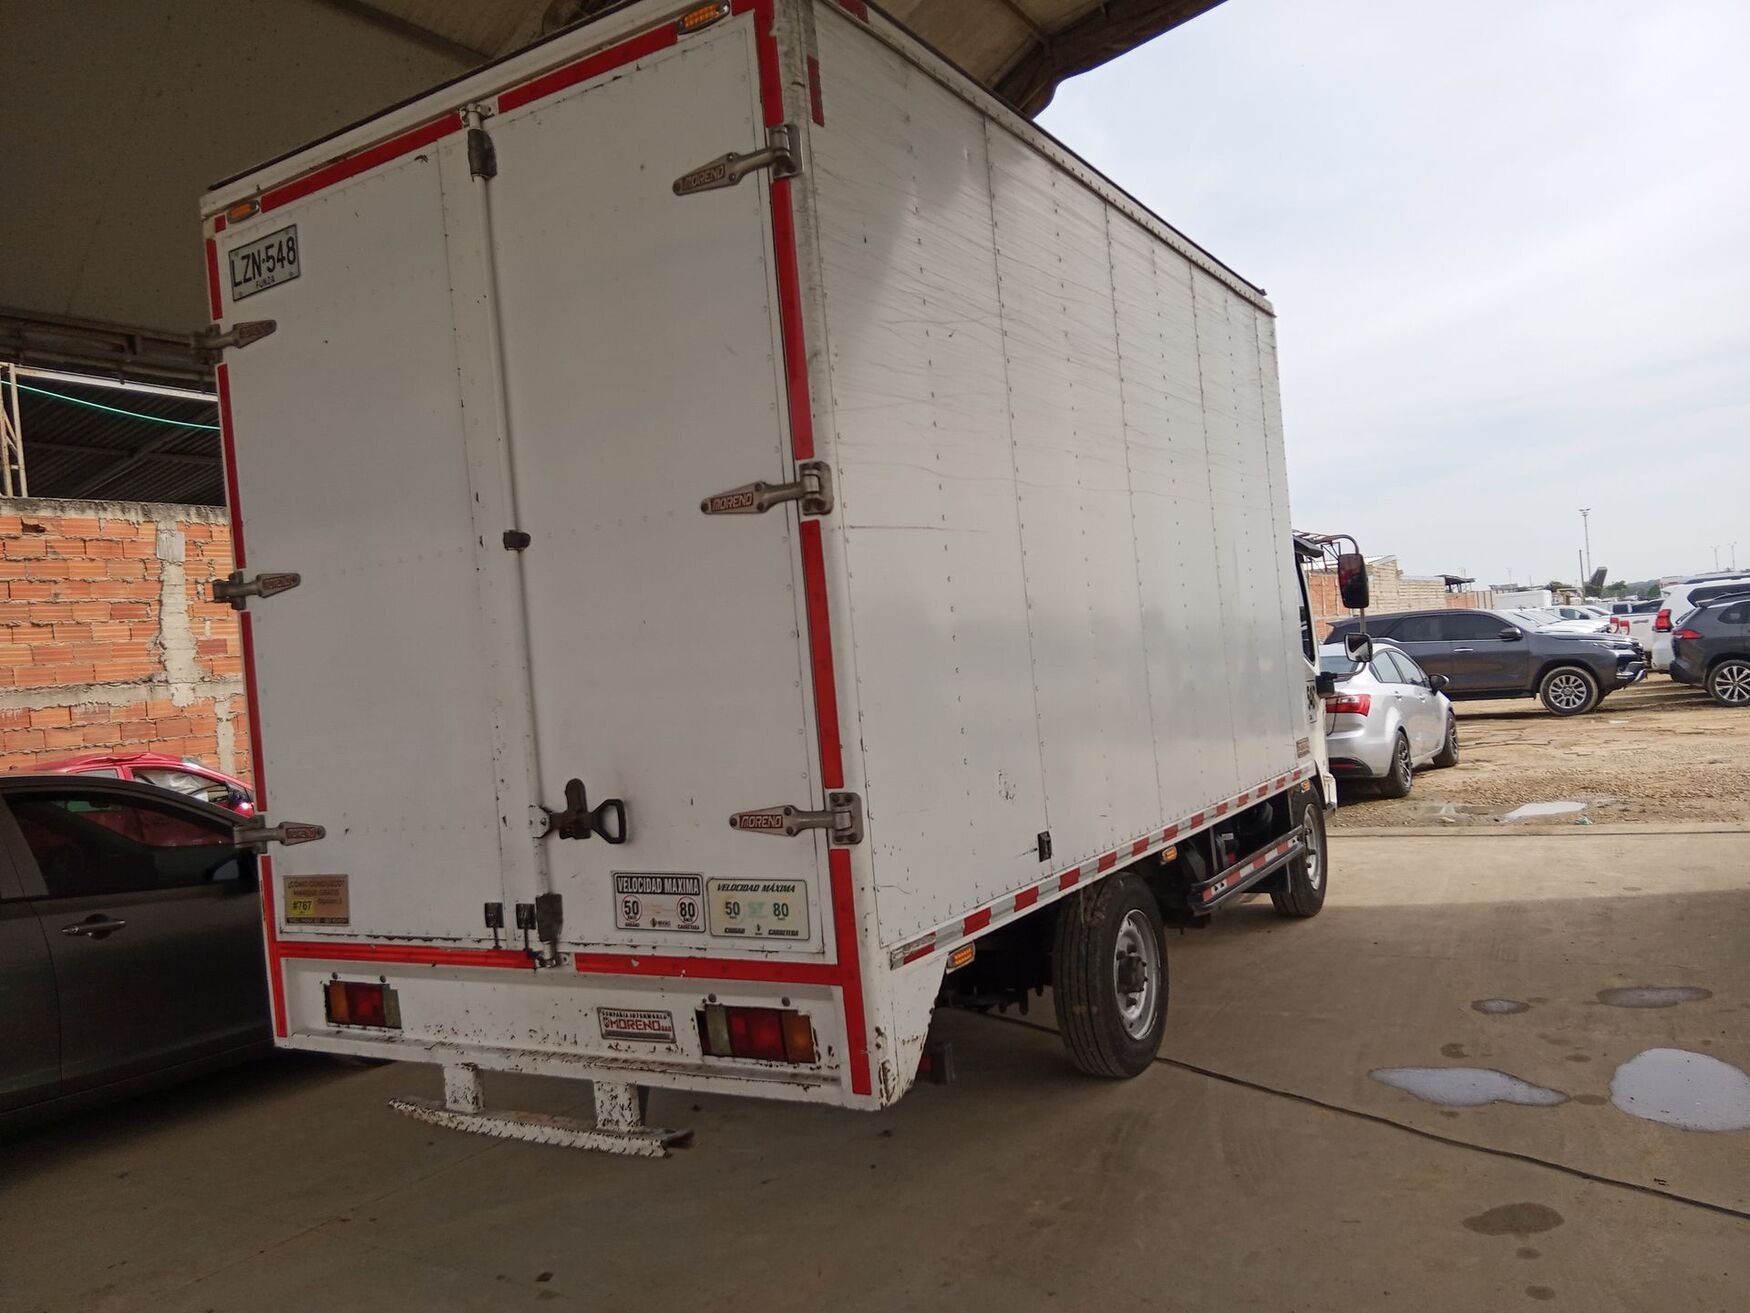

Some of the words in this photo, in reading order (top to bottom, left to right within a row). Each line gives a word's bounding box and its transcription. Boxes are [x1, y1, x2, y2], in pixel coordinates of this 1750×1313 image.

[711, 493, 753, 511] MORENO
[740, 815, 783, 828] MORENO
[617, 877, 663, 893] VELOCIDAD
[664, 878, 700, 894] MAXIMA
[717, 883, 760, 892] VELOCIDAD
[761, 883, 796, 893] MÁXIMA
[293, 900, 312, 911] #767
[624, 900, 640, 916] 50
[680, 902, 696, 918] 80
[725, 901, 740, 916] 50
[773, 902, 789, 917] 80
[609, 1019, 661, 1031] MORENO
